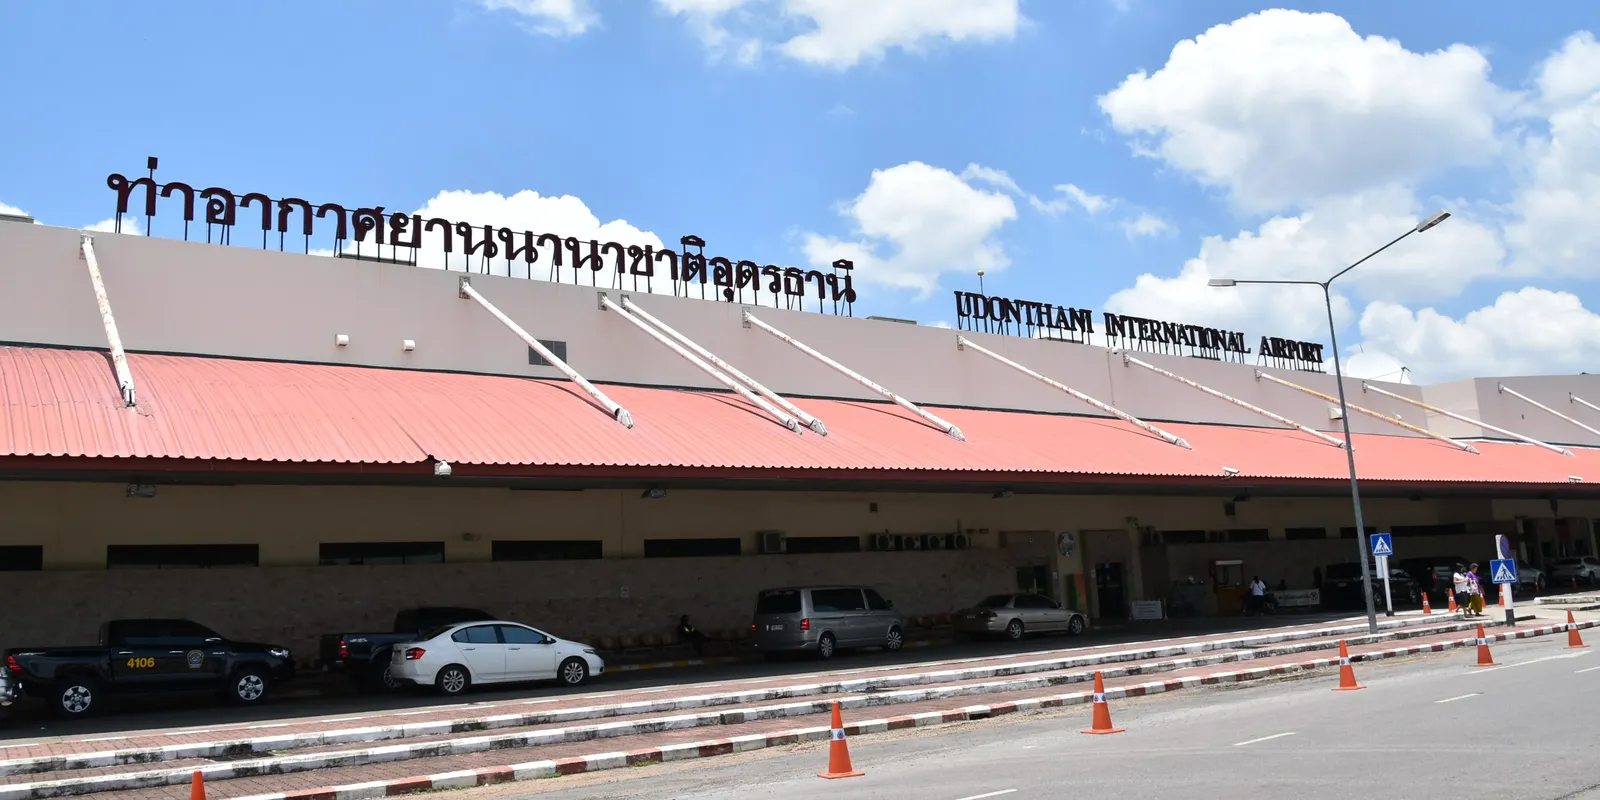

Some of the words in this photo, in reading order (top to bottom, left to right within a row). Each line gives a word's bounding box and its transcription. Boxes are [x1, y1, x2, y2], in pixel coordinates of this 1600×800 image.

[107, 156, 856, 304] ท่าอากาศยานนานาชาติอุดรธานี
[954, 290, 1094, 333] UDONTHANI
[1103, 312, 1251, 354] INTERNATIONAL
[1259, 335, 1323, 364] AIRPORT
[127, 657, 155, 669] 4106
